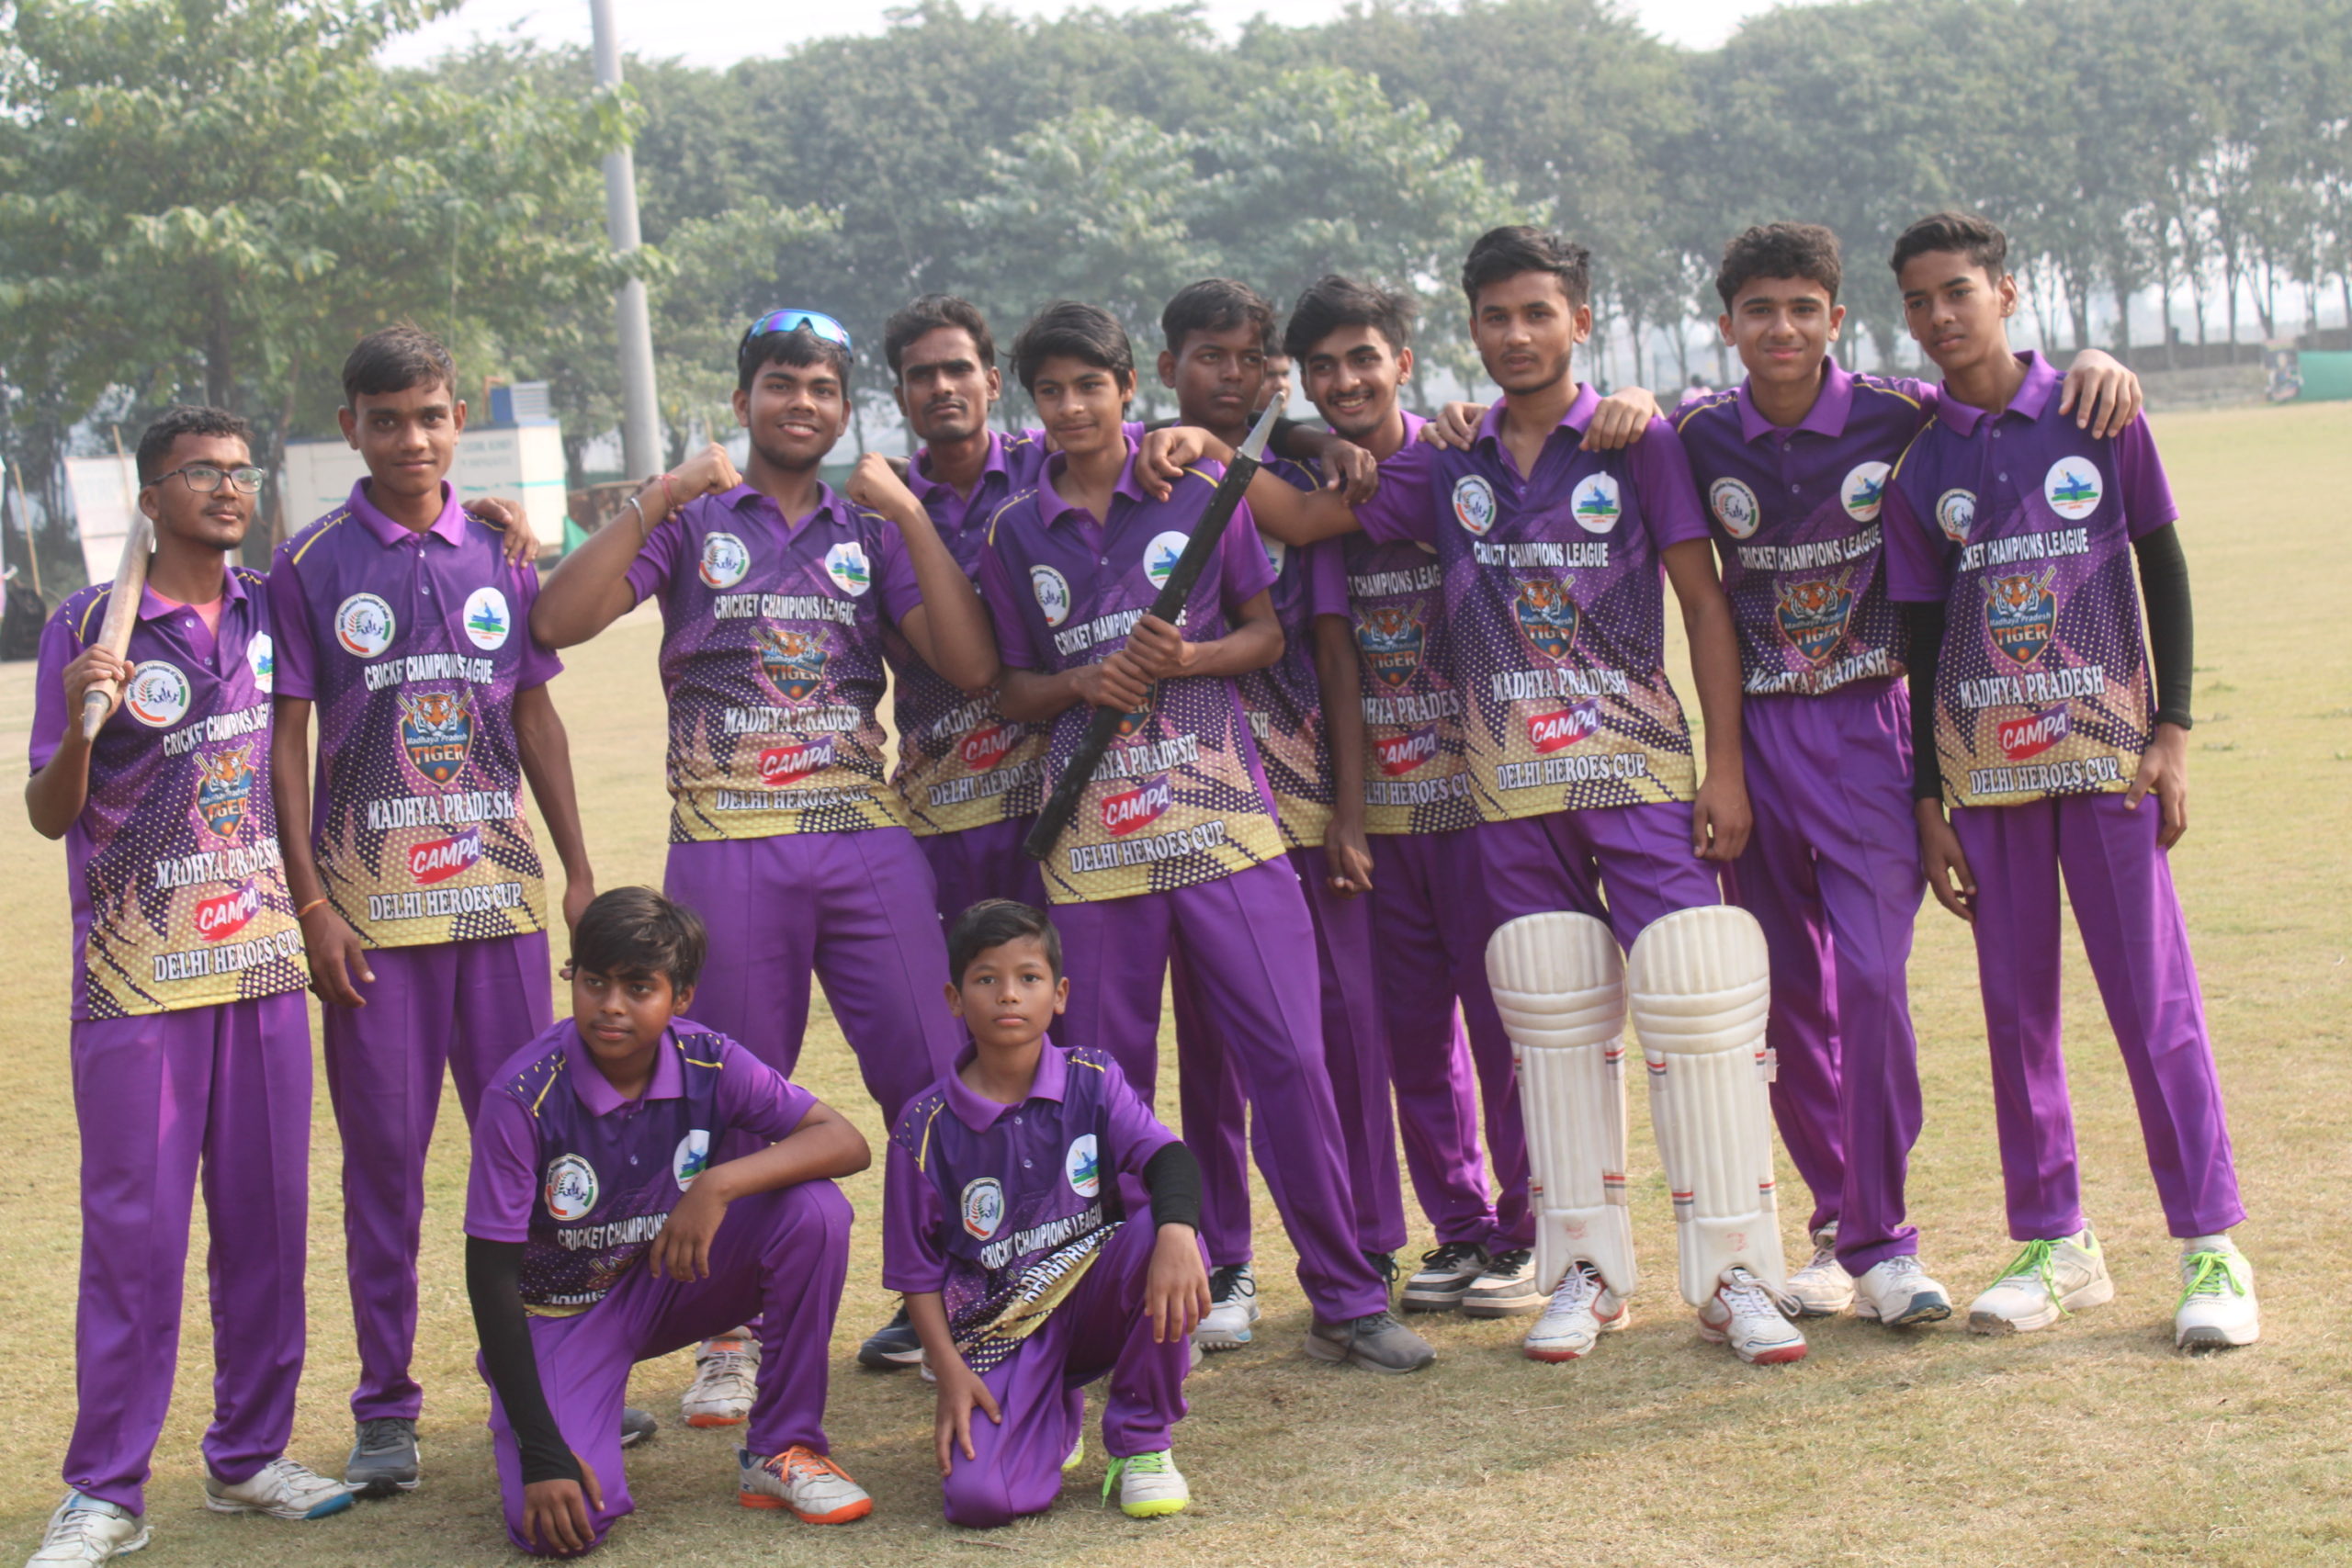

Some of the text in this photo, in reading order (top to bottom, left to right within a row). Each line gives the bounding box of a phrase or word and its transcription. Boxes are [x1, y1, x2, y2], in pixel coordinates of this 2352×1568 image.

[1509, 542, 1564, 568] CHAMPIONS
[1566, 542, 1609, 568] LEAGUE
[1737, 524, 1882, 571] CRICKET CHAMPIONS LEAGUE
[1958, 528, 2089, 572] CKET CHAMPIONS LEAGUE
[1354, 570, 1413, 598] CHAMPIONS
[1414, 565, 1442, 591] LEAG
[714, 593, 759, 620] CRICKET
[762, 593, 820, 621] CHAMPIONS
[1091, 608, 1143, 642] HAMPIONS
[2021, 612, 2052, 623] Pradesh
[1995, 623, 2050, 646] TIGER
[406, 653, 466, 682] CHAMPIONS
[466, 658, 493, 684] AGUE
[1369, 650, 1417, 669] TIGER
[1813, 647, 1890, 695] PRADESH
[1492, 667, 1630, 702] MADHYA PRADESH
[1959, 665, 2106, 709] MADHYA PRADESH
[724, 705, 861, 734] MADHYA PRADESH
[1361, 689, 1460, 726] DHYA PRADES
[1532, 707, 1597, 743] CAMPA
[441, 733, 468, 743] Pradesh
[1378, 731, 1437, 766] CAMPA
[2002, 713, 2066, 750] CAMPA
[411, 744, 466, 764] TIGER
[763, 744, 831, 776] CAMPA
[1129, 733, 1200, 776] PRADESH
[1497, 752, 1647, 790] DELHI HEROES CUP
[928, 777, 978, 807] DELHI
[978, 760, 1038, 797] HEROES
[1363, 773, 1470, 806] LHI HEROES CU
[1969, 757, 2119, 795] DELHI HEROES CUP
[368, 790, 515, 830] MADHYA PRADESH
[716, 789, 769, 810] DELHI
[773, 787, 840, 809] HEROES
[1106, 784, 1170, 825] CAMPA
[154, 837, 282, 889] MADHYA PRDESH
[413, 836, 479, 874] CAMPA
[1069, 819, 1226, 873] DELHI HEROES CUP
[199, 887, 259, 931] CAMPA
[368, 882, 522, 921] DELHI HEROES CUP
[153, 949, 210, 982] DELHI
[212, 936, 275, 974] HEROES
[557, 1226, 605, 1251] CRICKET
[980, 1235, 1012, 1270] CRICK
[1014, 1217, 1072, 1257] CHAMPIONS
[1072, 1201, 1102, 1236] LEAGU
